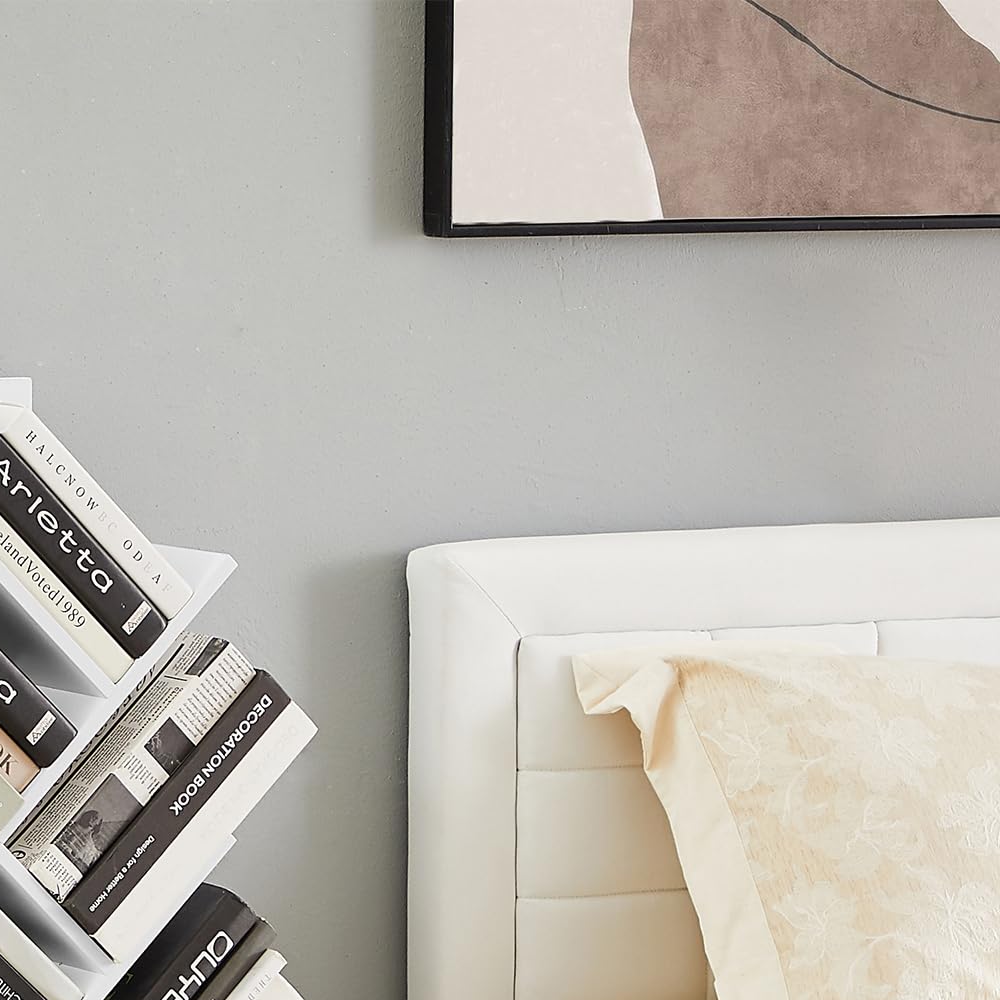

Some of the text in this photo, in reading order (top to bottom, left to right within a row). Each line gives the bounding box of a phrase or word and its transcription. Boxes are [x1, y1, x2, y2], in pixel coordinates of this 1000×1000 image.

[200, 694, 273, 778] DECORATION
[168, 774, 206, 816] BOOK
[133, 834, 156, 859] Design
[125, 854, 139, 870] for
[104, 871, 125, 893] Better
[88, 889, 109, 912] Home
